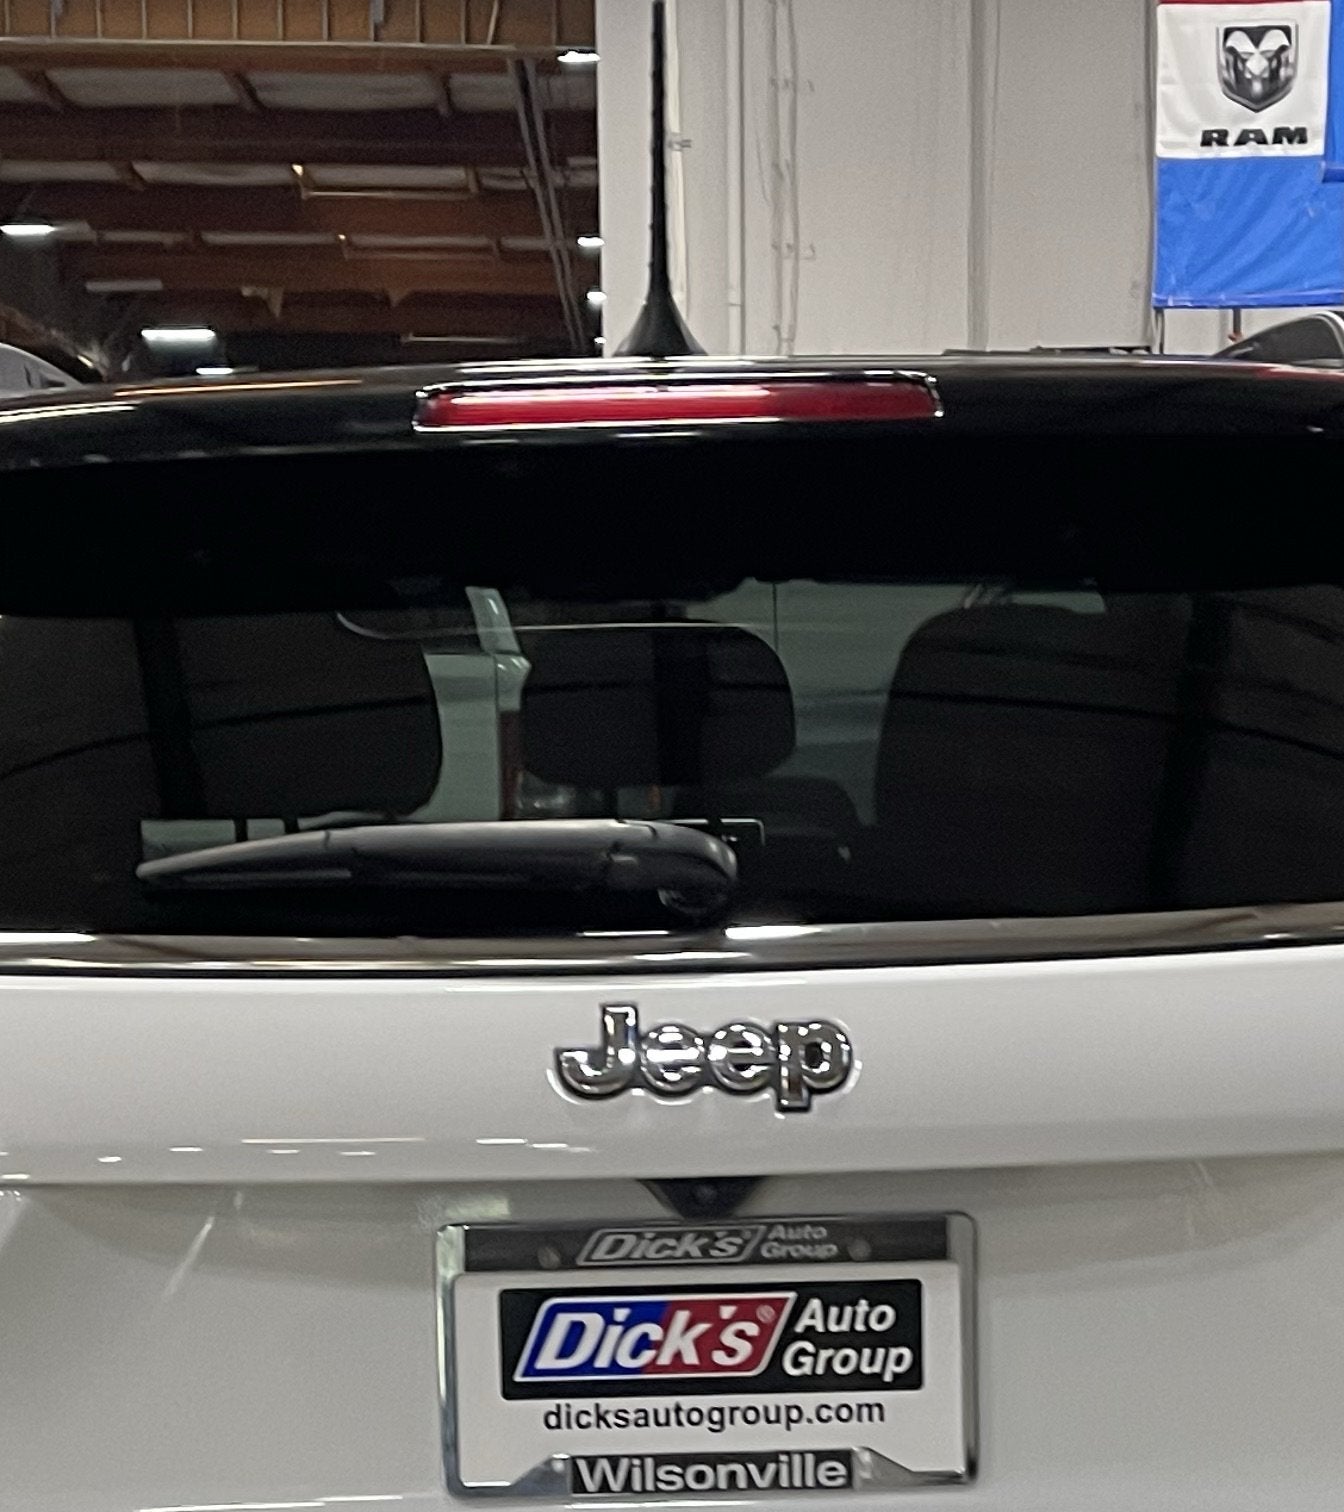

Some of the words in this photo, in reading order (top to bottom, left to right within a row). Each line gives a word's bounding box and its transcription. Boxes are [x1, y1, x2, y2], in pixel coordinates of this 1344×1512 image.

[1199, 125, 1308, 148] RAM
[554, 1001, 855, 1113] Jeep
[590, 1231, 744, 1261] Dick's
[767, 1224, 827, 1240] Auto
[760, 1241, 838, 1259] Group
[533, 1304, 761, 1371] Dick's
[794, 1297, 896, 1333] Auto
[781, 1339, 913, 1383] Group
[543, 1401, 886, 1433] dicksautogroup.com
[575, 1452, 848, 1493] Wilsonville
